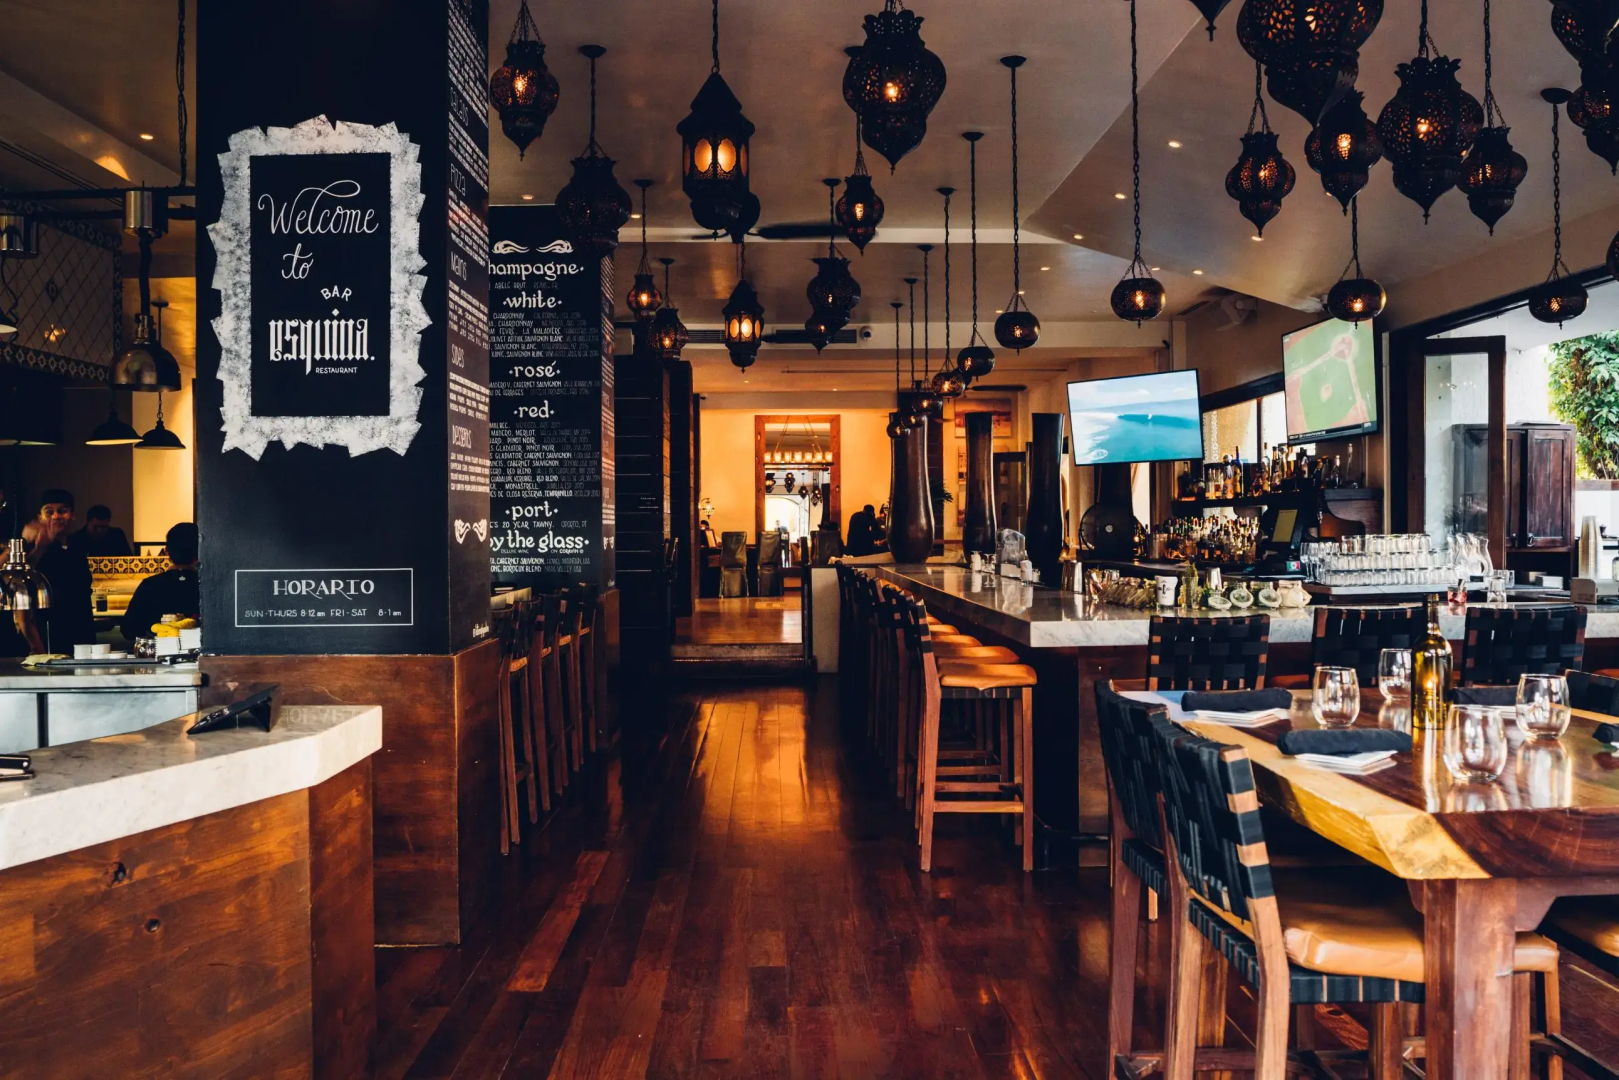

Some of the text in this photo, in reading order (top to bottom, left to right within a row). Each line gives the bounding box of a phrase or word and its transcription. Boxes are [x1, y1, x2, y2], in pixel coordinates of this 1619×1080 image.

[258, 180, 379, 234] Welcome
[281, 243, 314, 280] to
[320, 286, 352, 302] BAR
[506, 290, 557, 308] white
[512, 360, 556, 378] rosé
[518, 400, 550, 418] red
[511, 500, 552, 520] port
[506, 530, 535, 548] the
[537, 530, 583, 553] glass
[273, 580, 375, 600] HORARIO
